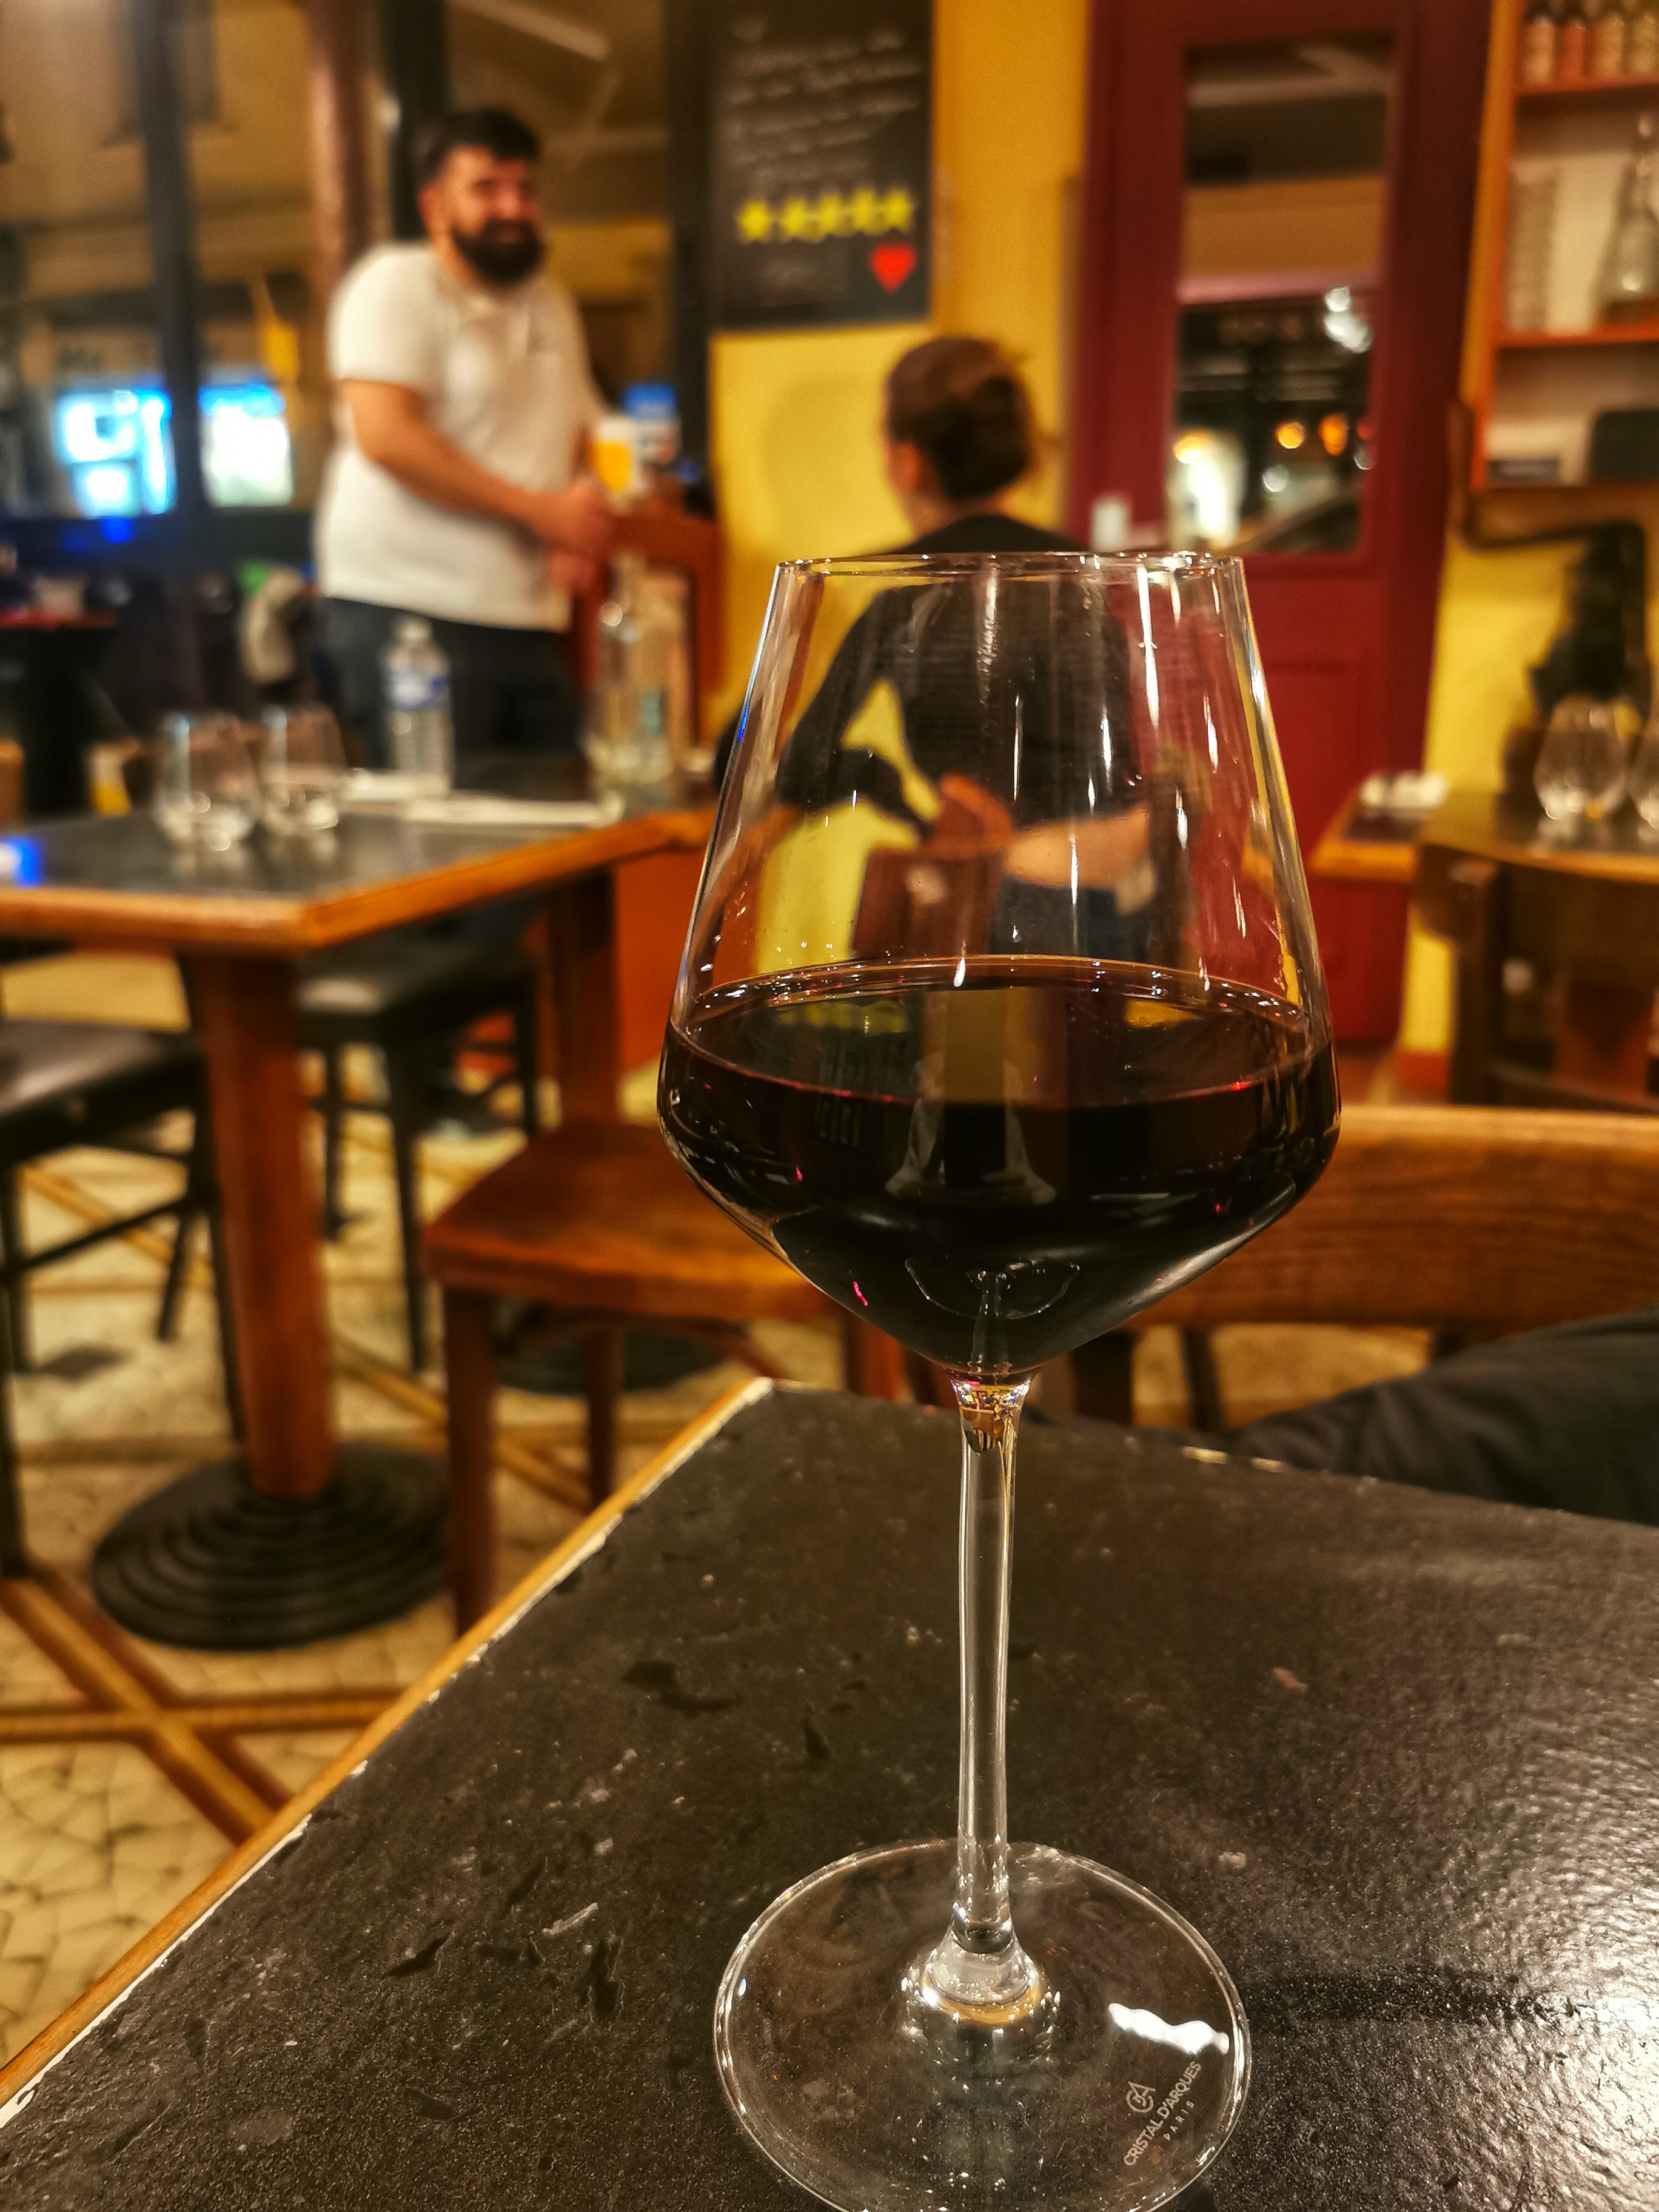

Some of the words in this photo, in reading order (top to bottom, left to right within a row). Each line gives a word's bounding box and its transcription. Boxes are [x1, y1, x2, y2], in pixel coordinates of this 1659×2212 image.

[1124, 2120, 1164, 2165] CRISTAL
[1157, 2061, 1201, 2119] D'ARQUES
[1163, 2101, 1195, 2140] PARIS
